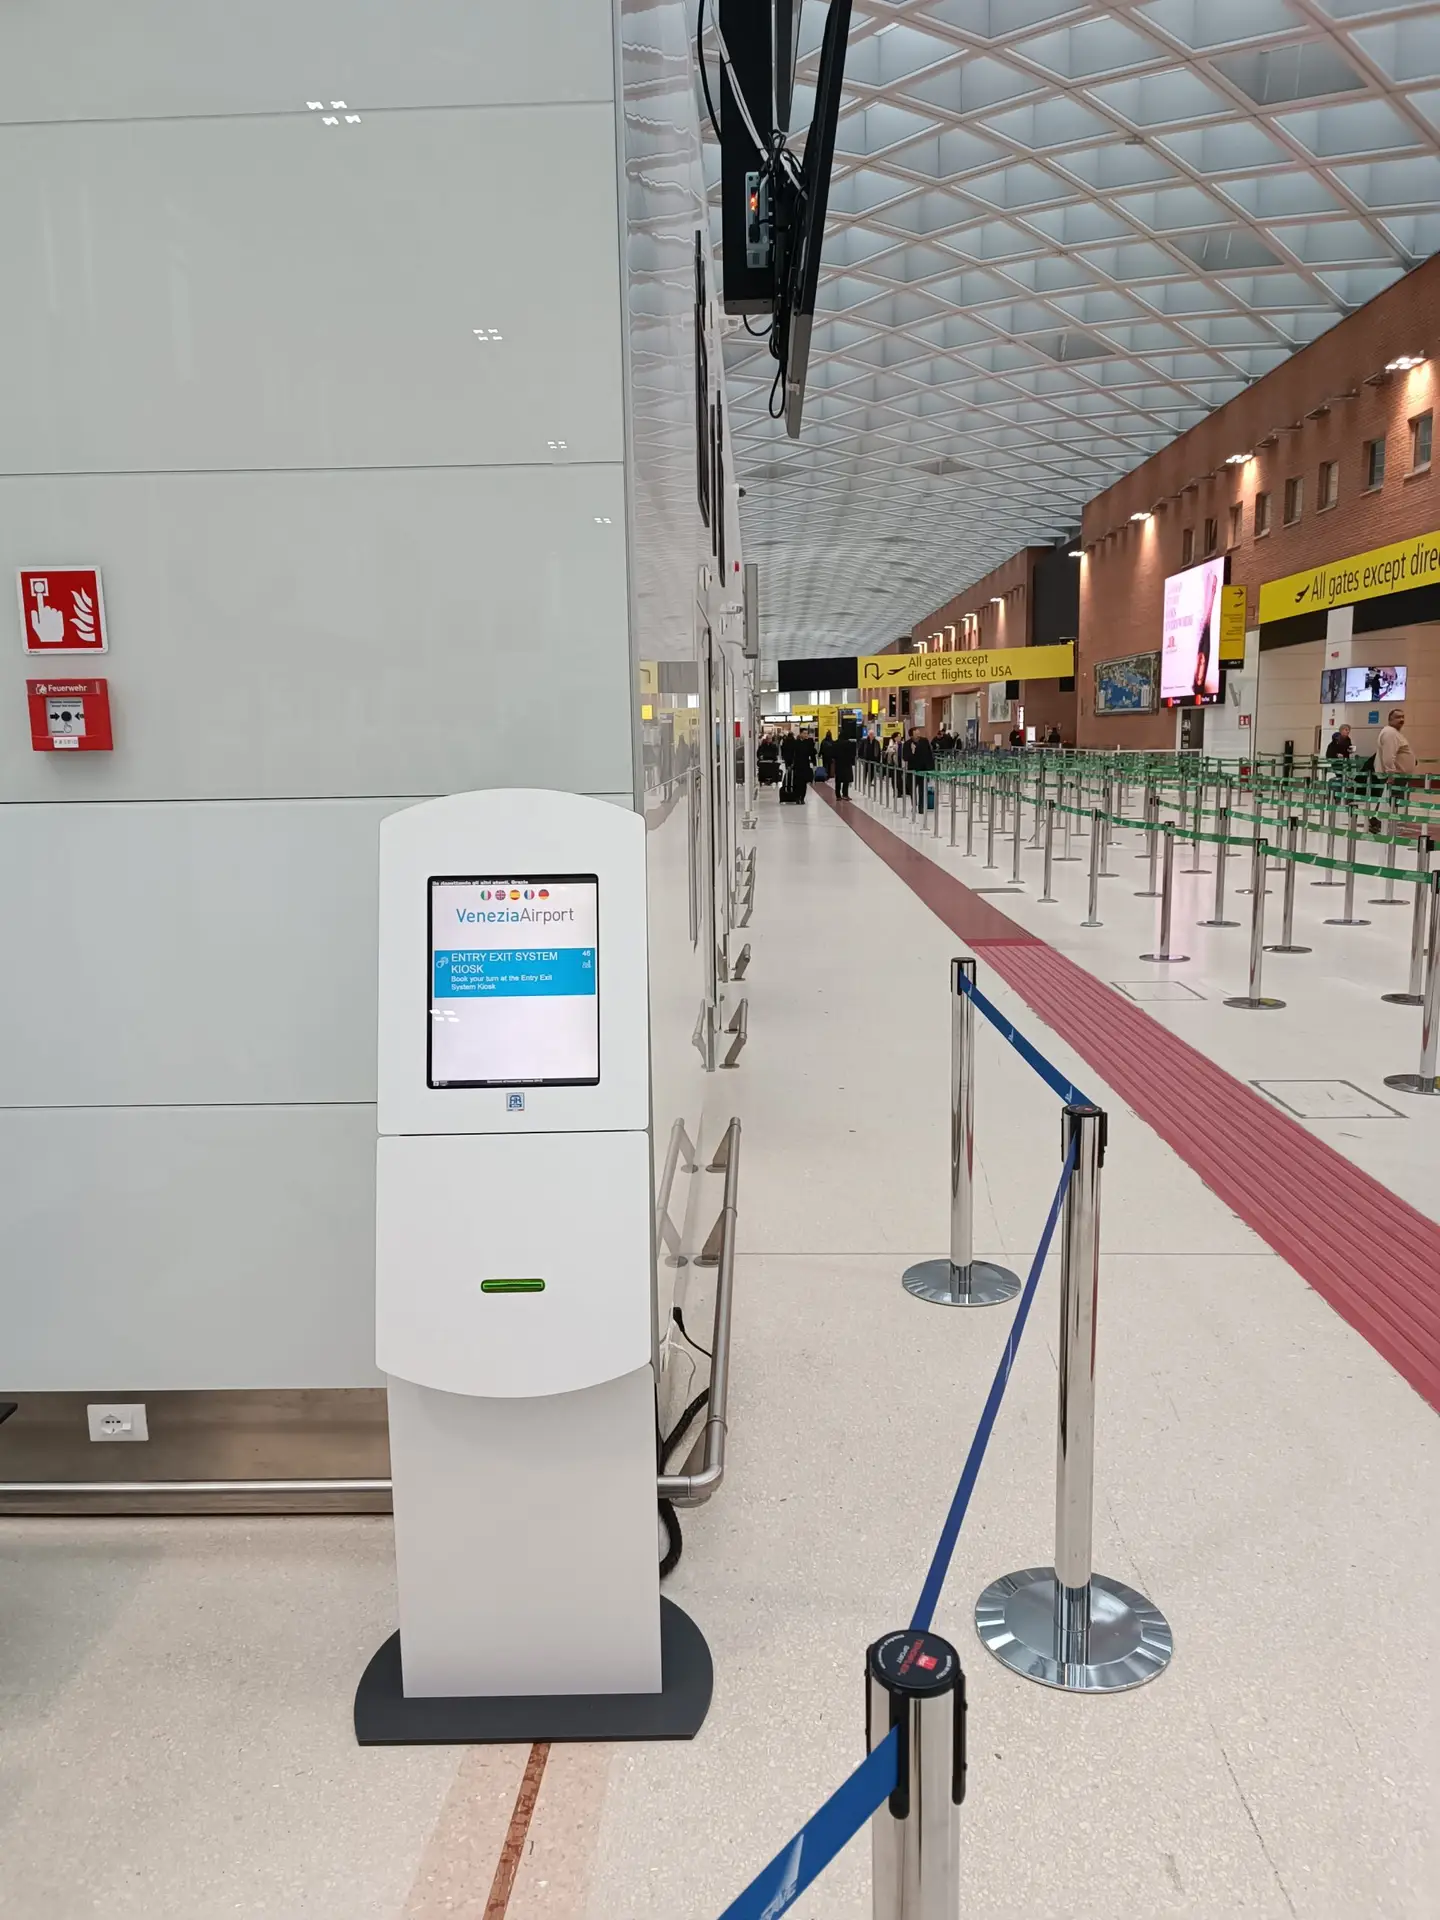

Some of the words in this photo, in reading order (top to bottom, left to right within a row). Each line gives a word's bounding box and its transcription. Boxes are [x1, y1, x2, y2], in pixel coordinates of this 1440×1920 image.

[1311, 571, 1326, 602] All
[1328, 569, 1359, 604] gates
[1363, 552, 1406, 590] except
[1411, 543, 1440, 575] dire
[908, 656, 922, 668] All
[925, 655, 953, 668] gates
[955, 654, 989, 668] except
[907, 670, 937, 682] direct
[941, 668, 973, 682] flights
[976, 668, 986, 678] to
[990, 666, 1012, 677] USA
[48, 684, 87, 692] Feuerwehr
[456, 907, 574, 925] VeneziaAirport
[451, 952, 487, 963] ENTRY
[489, 952, 513, 962] EXIT
[515, 951, 558, 961] SYSTEM
[451, 964, 484, 974] KIOSK
[469, 976, 484, 984] your
[521, 974, 538, 983] Entry
[540, 973, 552, 981] Exit
[451, 983, 476, 991] System
